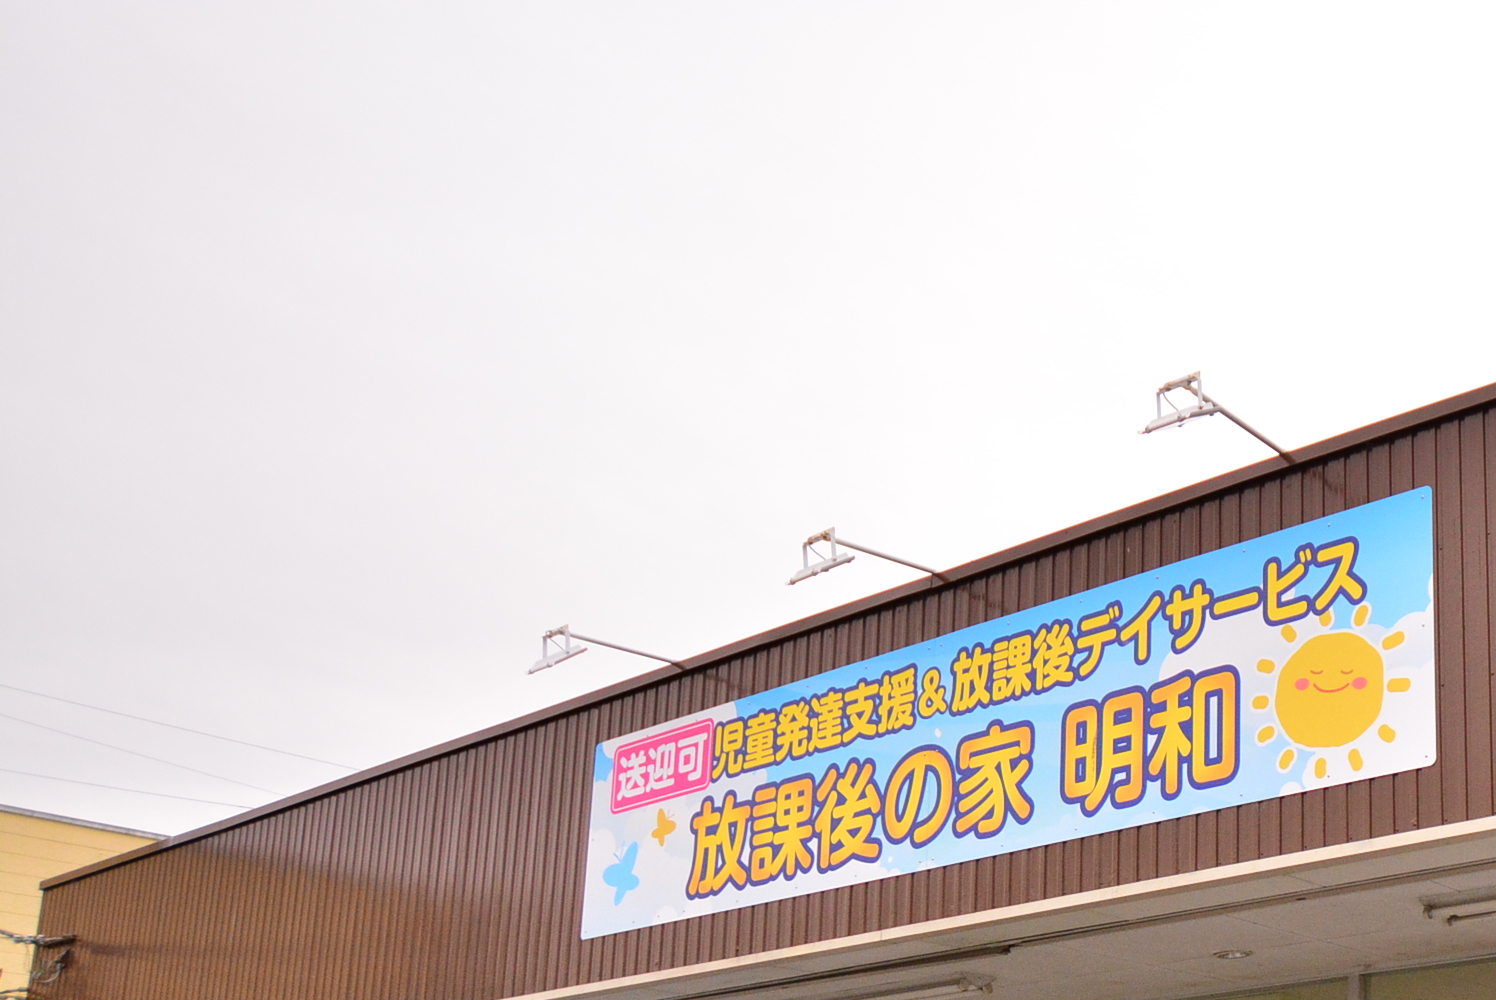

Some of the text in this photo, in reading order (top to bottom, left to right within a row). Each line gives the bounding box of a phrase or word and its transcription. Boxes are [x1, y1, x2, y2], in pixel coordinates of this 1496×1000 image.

[617, 732, 708, 801] 送迎可
[686, 664, 1240, 899] 放課後の家 明和
